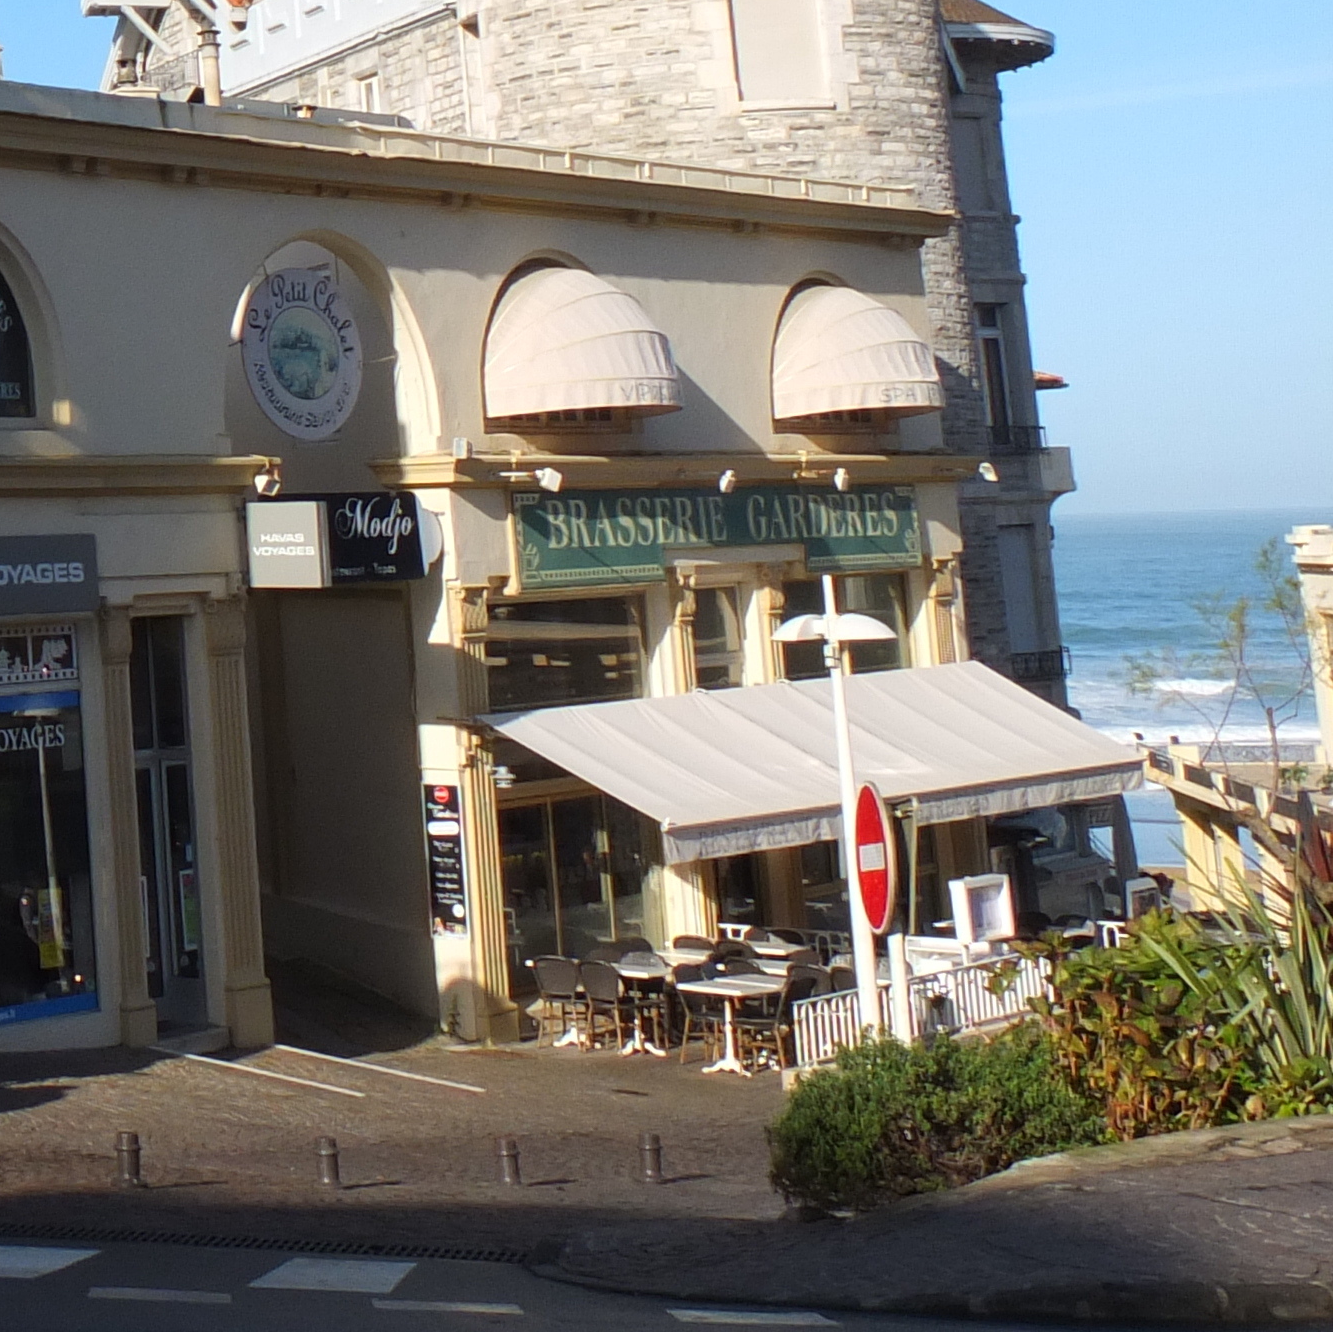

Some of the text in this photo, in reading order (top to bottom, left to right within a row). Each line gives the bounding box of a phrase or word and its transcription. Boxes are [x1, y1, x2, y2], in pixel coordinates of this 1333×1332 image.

[248, 274, 354, 360] Le Petit Chalet
[261, 533, 305, 543] HAVAS
[336, 497, 414, 555] Modjo
[546, 491, 899, 549] BRASSERIE GARDERES
[253, 546, 315, 556] VOYAGES
